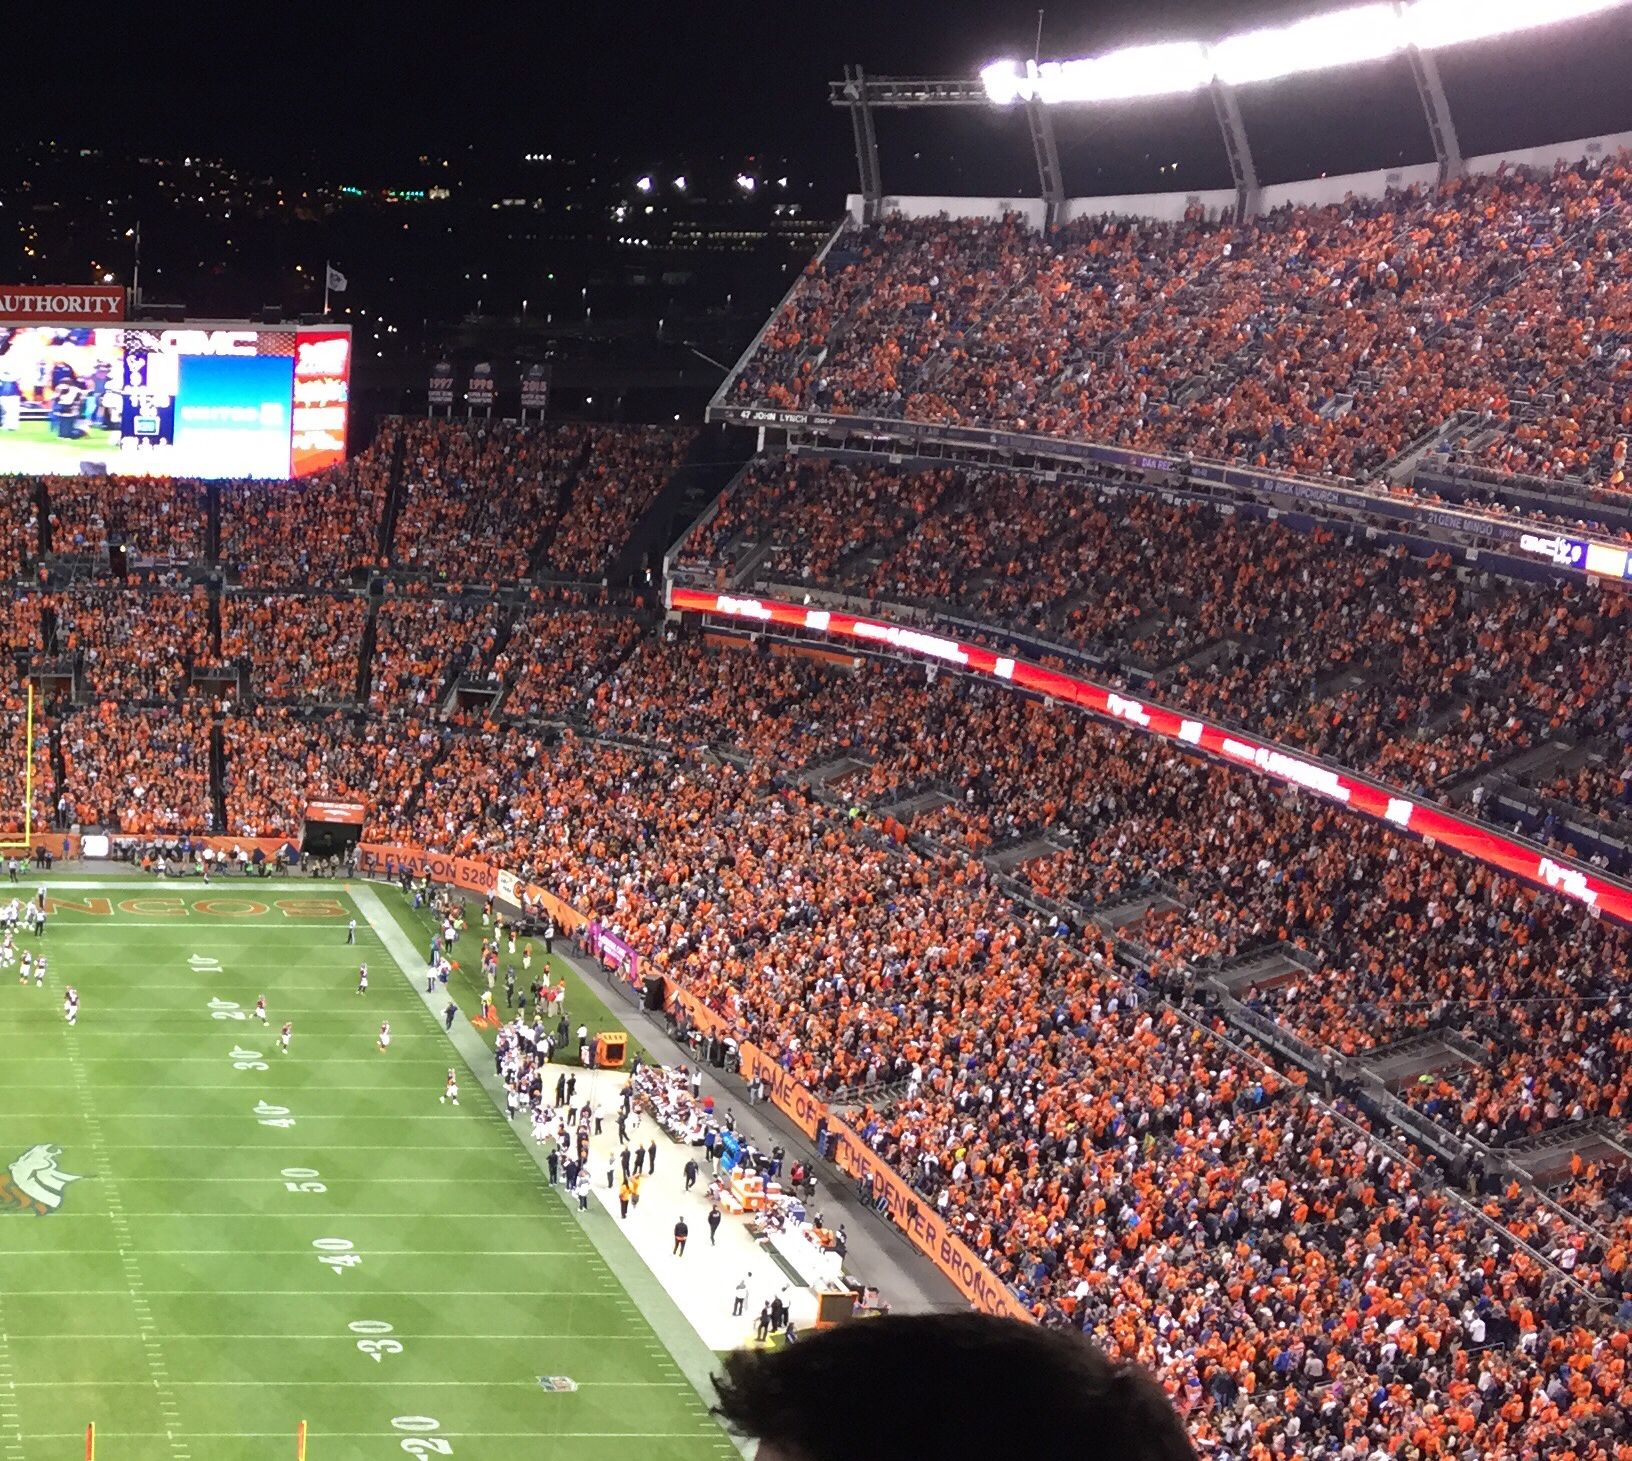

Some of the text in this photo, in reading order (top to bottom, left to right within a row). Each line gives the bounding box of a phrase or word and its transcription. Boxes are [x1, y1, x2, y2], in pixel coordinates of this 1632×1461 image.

[741, 410, 750, 418] 47
[753, 411, 776, 420] JOHN
[780, 412, 808, 423] LYNCH
[1438, 513, 1462, 530] GENE
[363, 850, 457, 878] ELEVATON
[207, 1000, 246, 1020] 20
[228, 1050, 269, 1071] 30
[752, 1057, 817, 1125] HOME OF
[252, 1105, 296, 1128] 40
[280, 1167, 327, 1193] 50
[842, 1136, 871, 1175] THE
[939, 1237, 1018, 1319] BRONCO
[311, 1237, 362, 1267] 40
[347, 1319, 404, 1354] 30
[390, 1415, 454, 1456] 20
